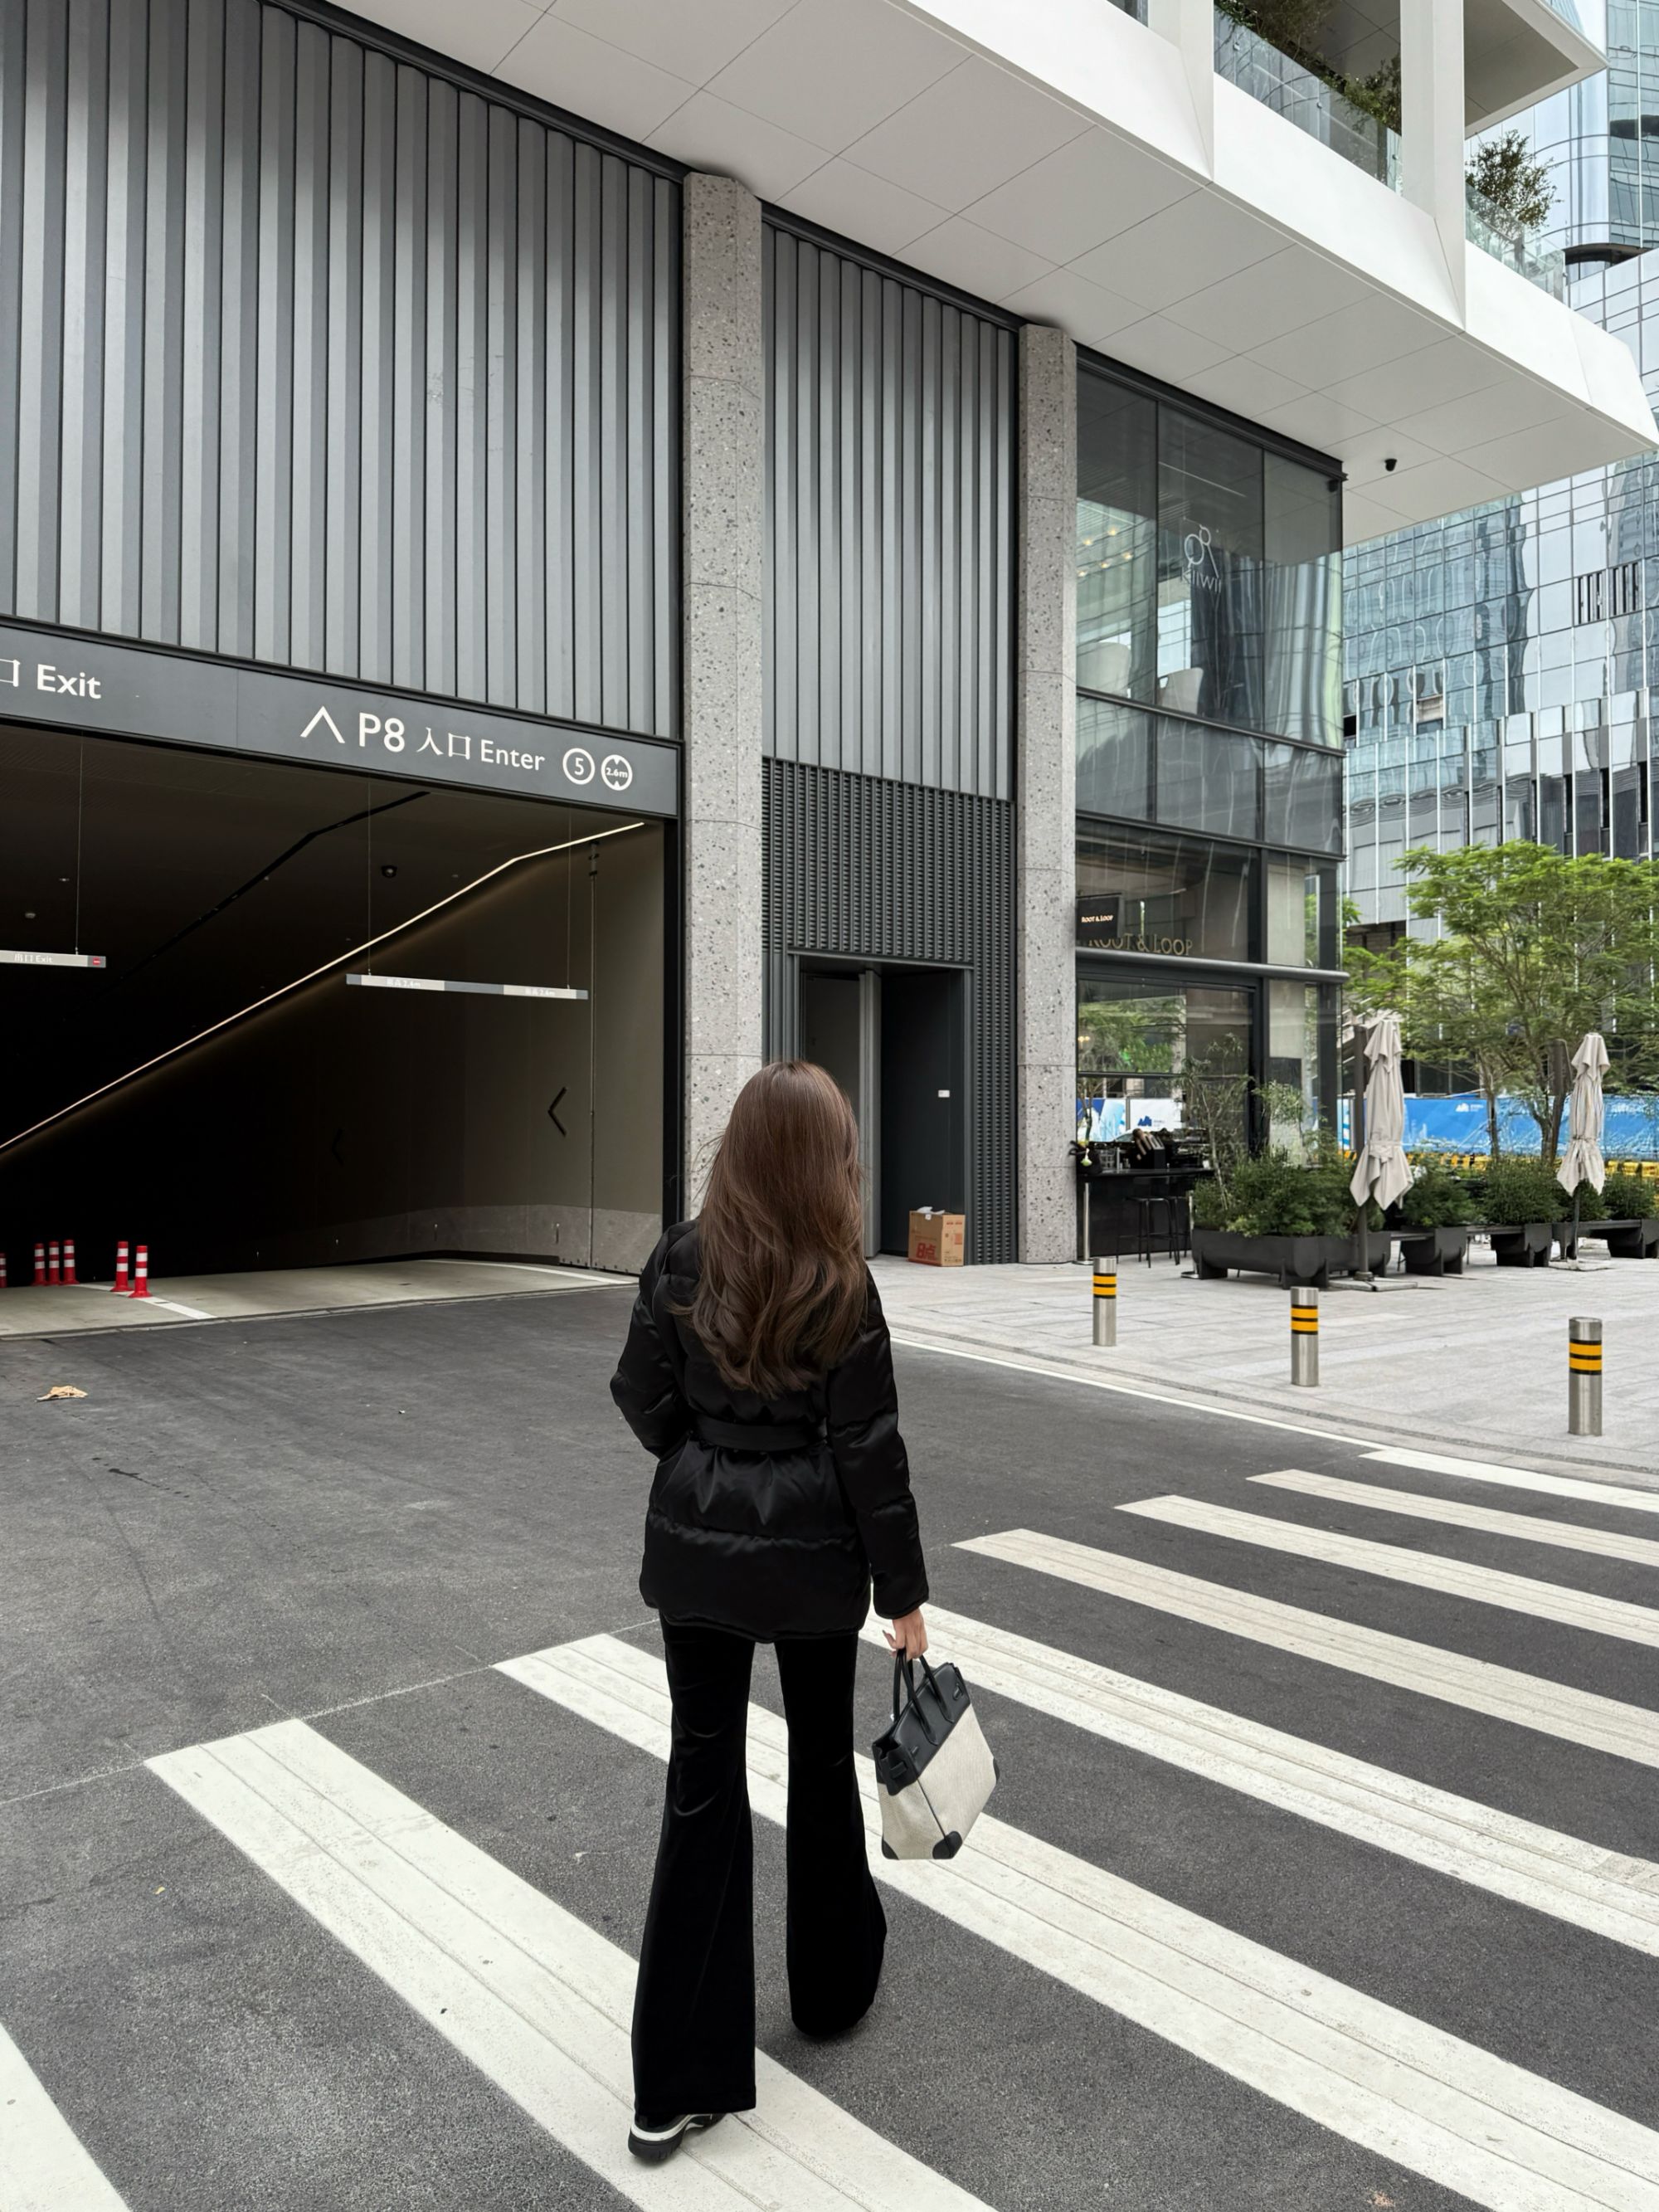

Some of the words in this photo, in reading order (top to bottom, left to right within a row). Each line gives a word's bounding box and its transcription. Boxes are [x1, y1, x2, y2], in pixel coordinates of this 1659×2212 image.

[37, 663, 101, 699] Exit
[358, 712, 405, 753] P8
[416, 727, 471, 760] 入口
[480, 738, 546, 771] Enter
[574, 757, 585, 776] 5
[605, 767, 629, 779] 2.6m
[35, 954, 54, 964] Exit
[1136, 933, 1150, 953] &
[1153, 933, 1194, 957] LOOP
